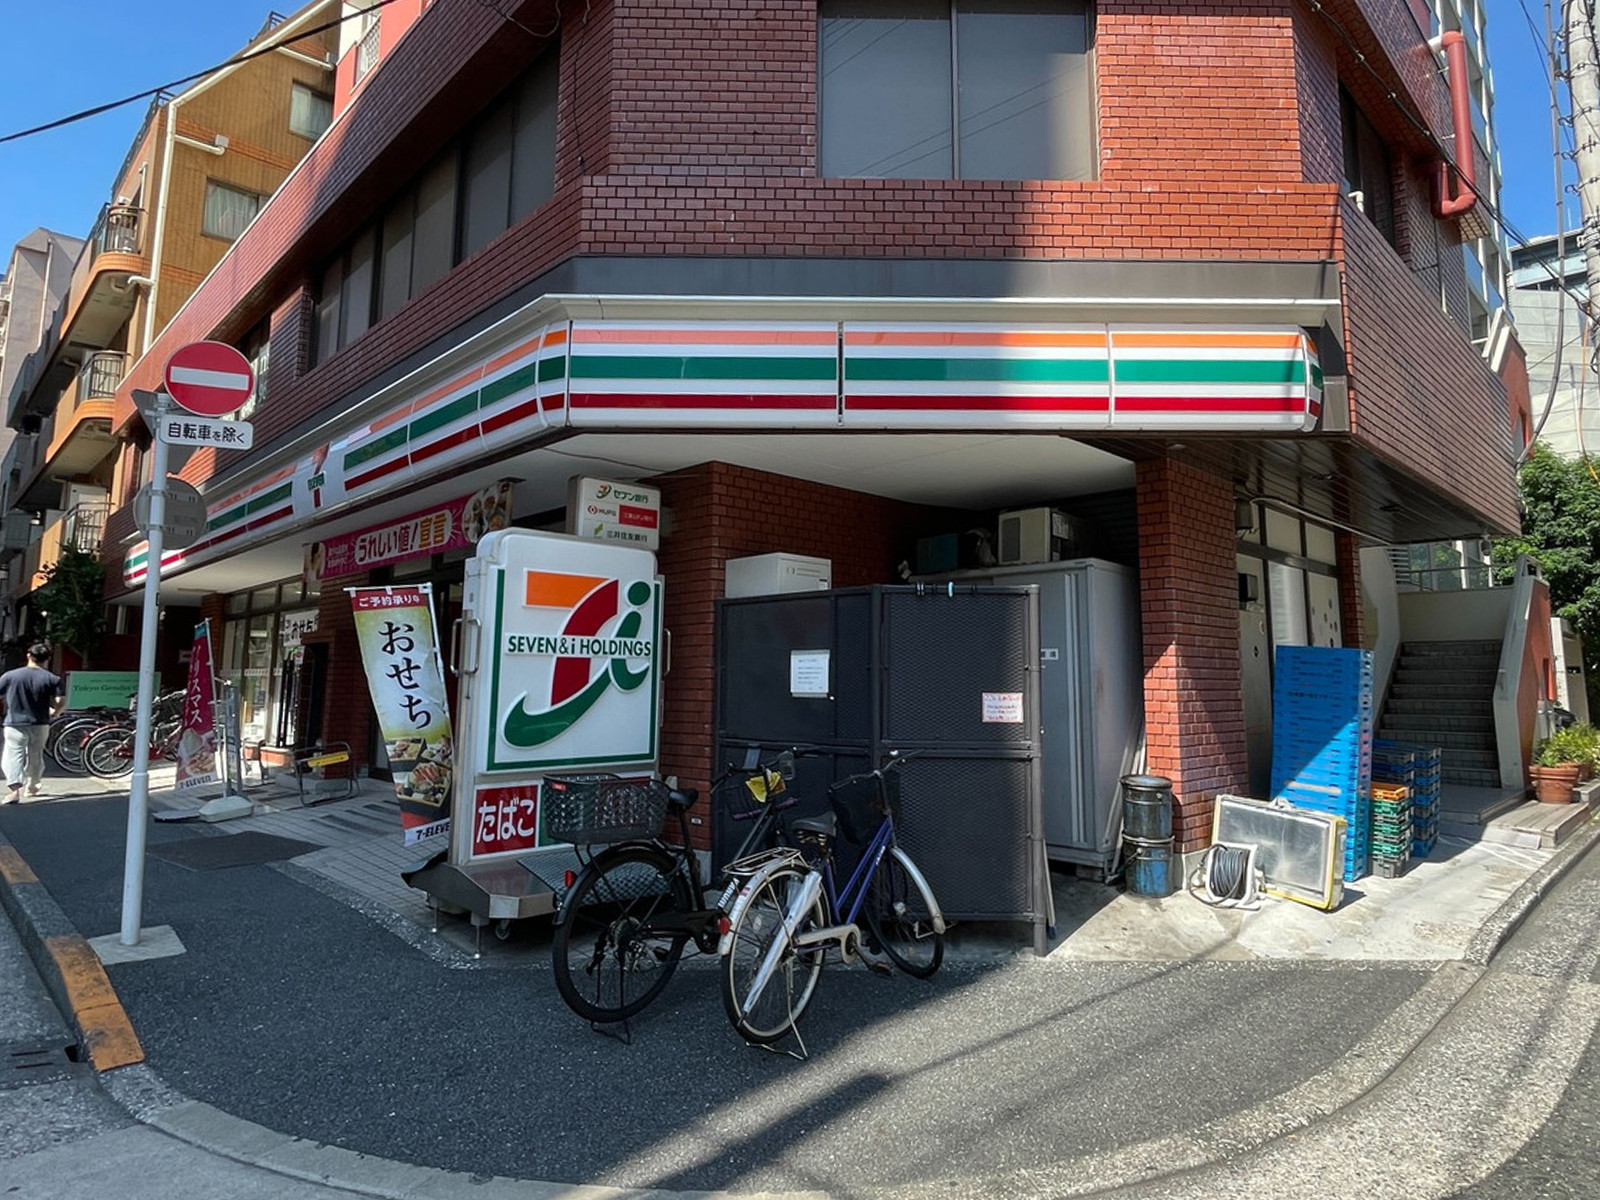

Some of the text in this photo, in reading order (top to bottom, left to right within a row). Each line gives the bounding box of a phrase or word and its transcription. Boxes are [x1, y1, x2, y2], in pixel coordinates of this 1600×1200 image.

[168, 422, 245, 444] 自転車を除く
[613, 489, 649, 504] セブン銀行
[579, 638, 651, 657] HOLDINGS
[378, 621, 432, 730] おせち
[476, 796, 535, 844] たばこ
